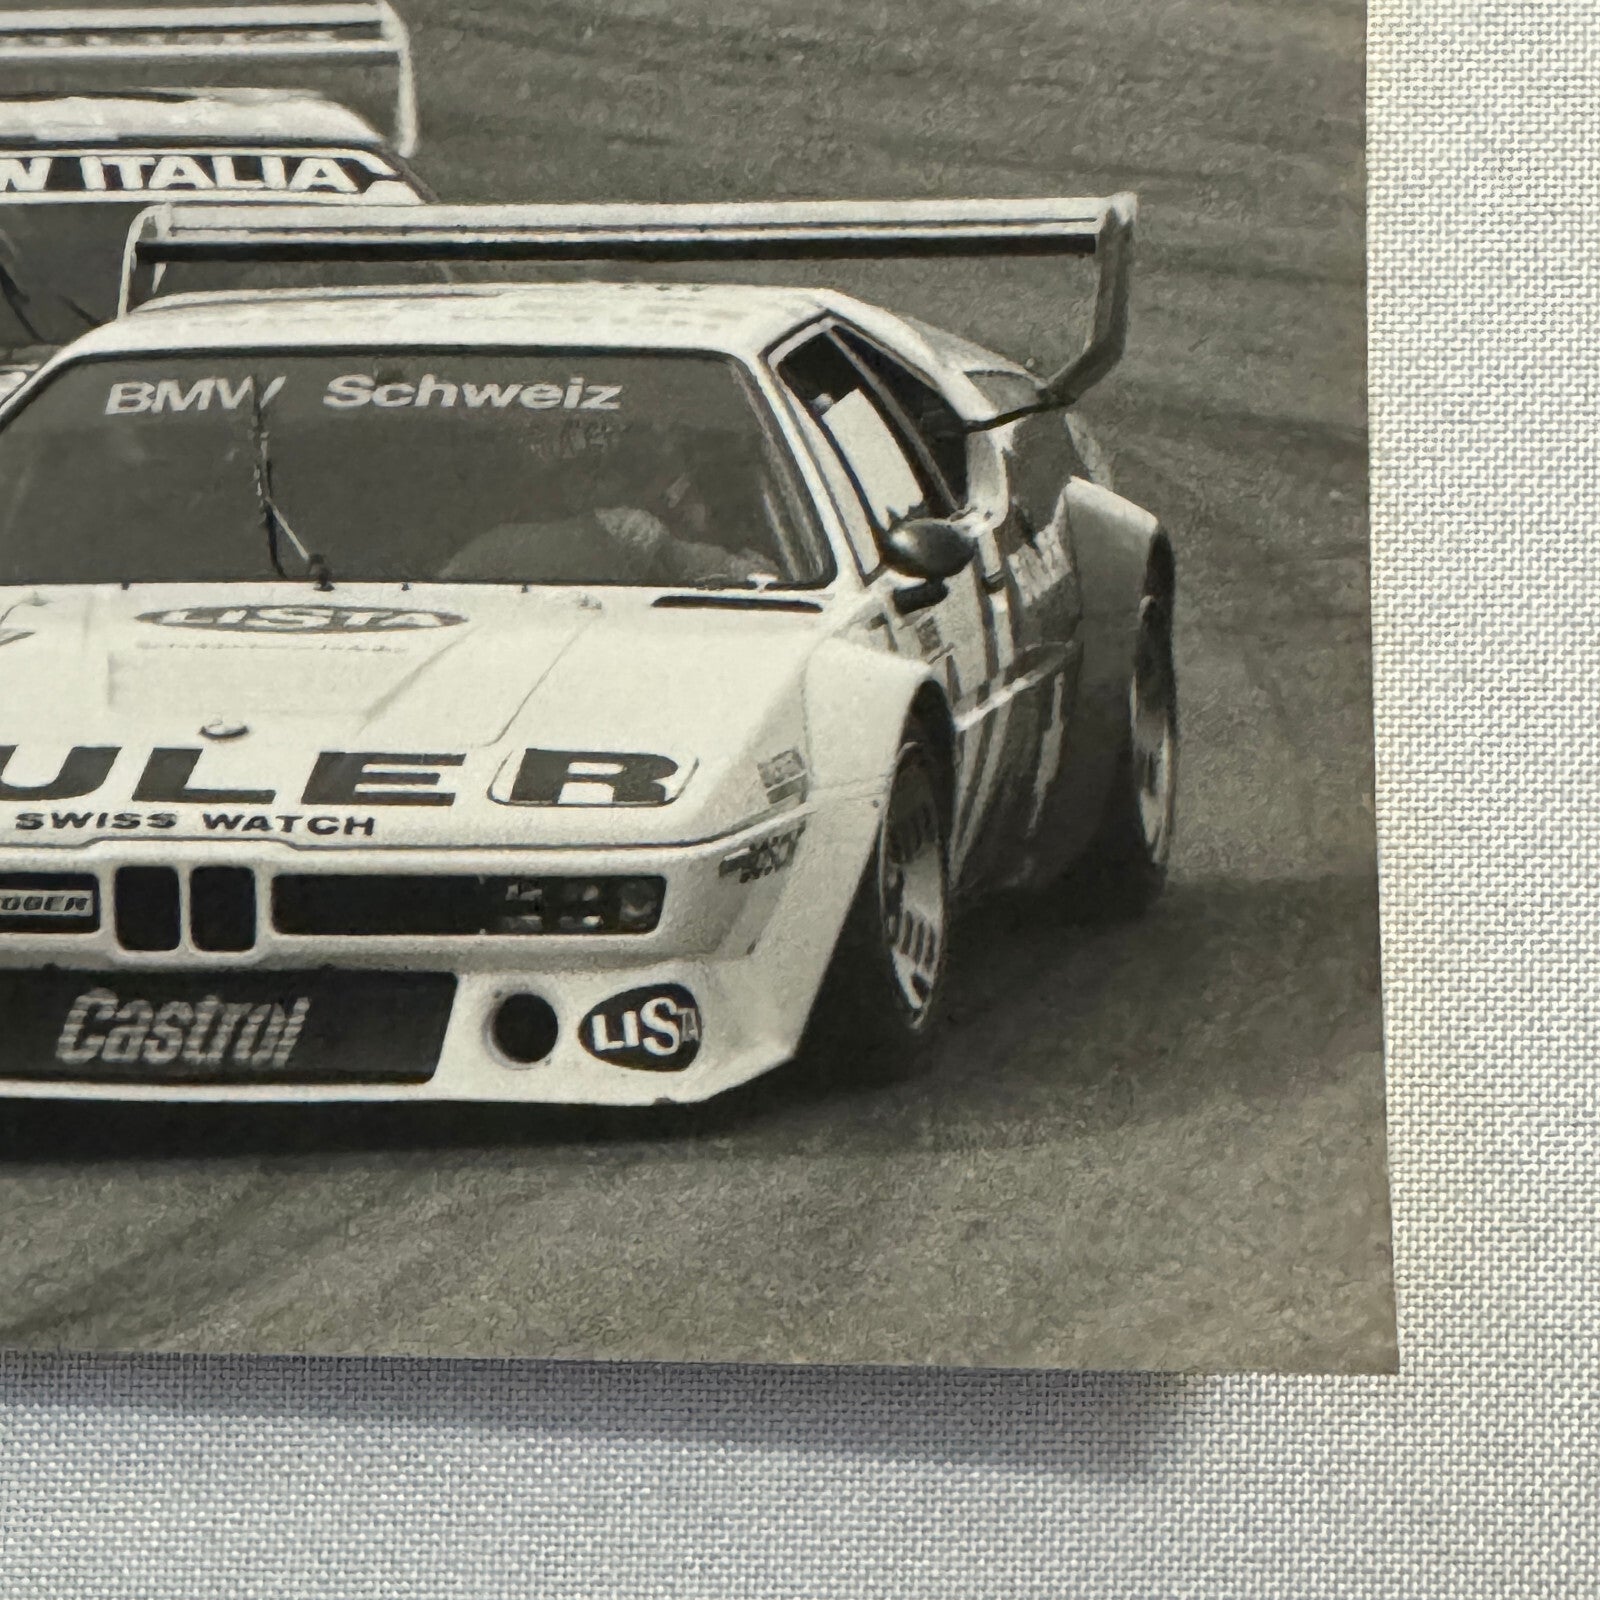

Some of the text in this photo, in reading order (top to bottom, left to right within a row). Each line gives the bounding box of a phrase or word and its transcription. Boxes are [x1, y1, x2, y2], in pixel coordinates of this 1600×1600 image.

[80, 155, 359, 192] ITALIA
[104, 373, 622, 414] BMW Schweiz
[160, 607, 443, 630] LISTA
[15, 812, 375, 836] SWISS WATCH
[56, 987, 310, 1069] Castrol
